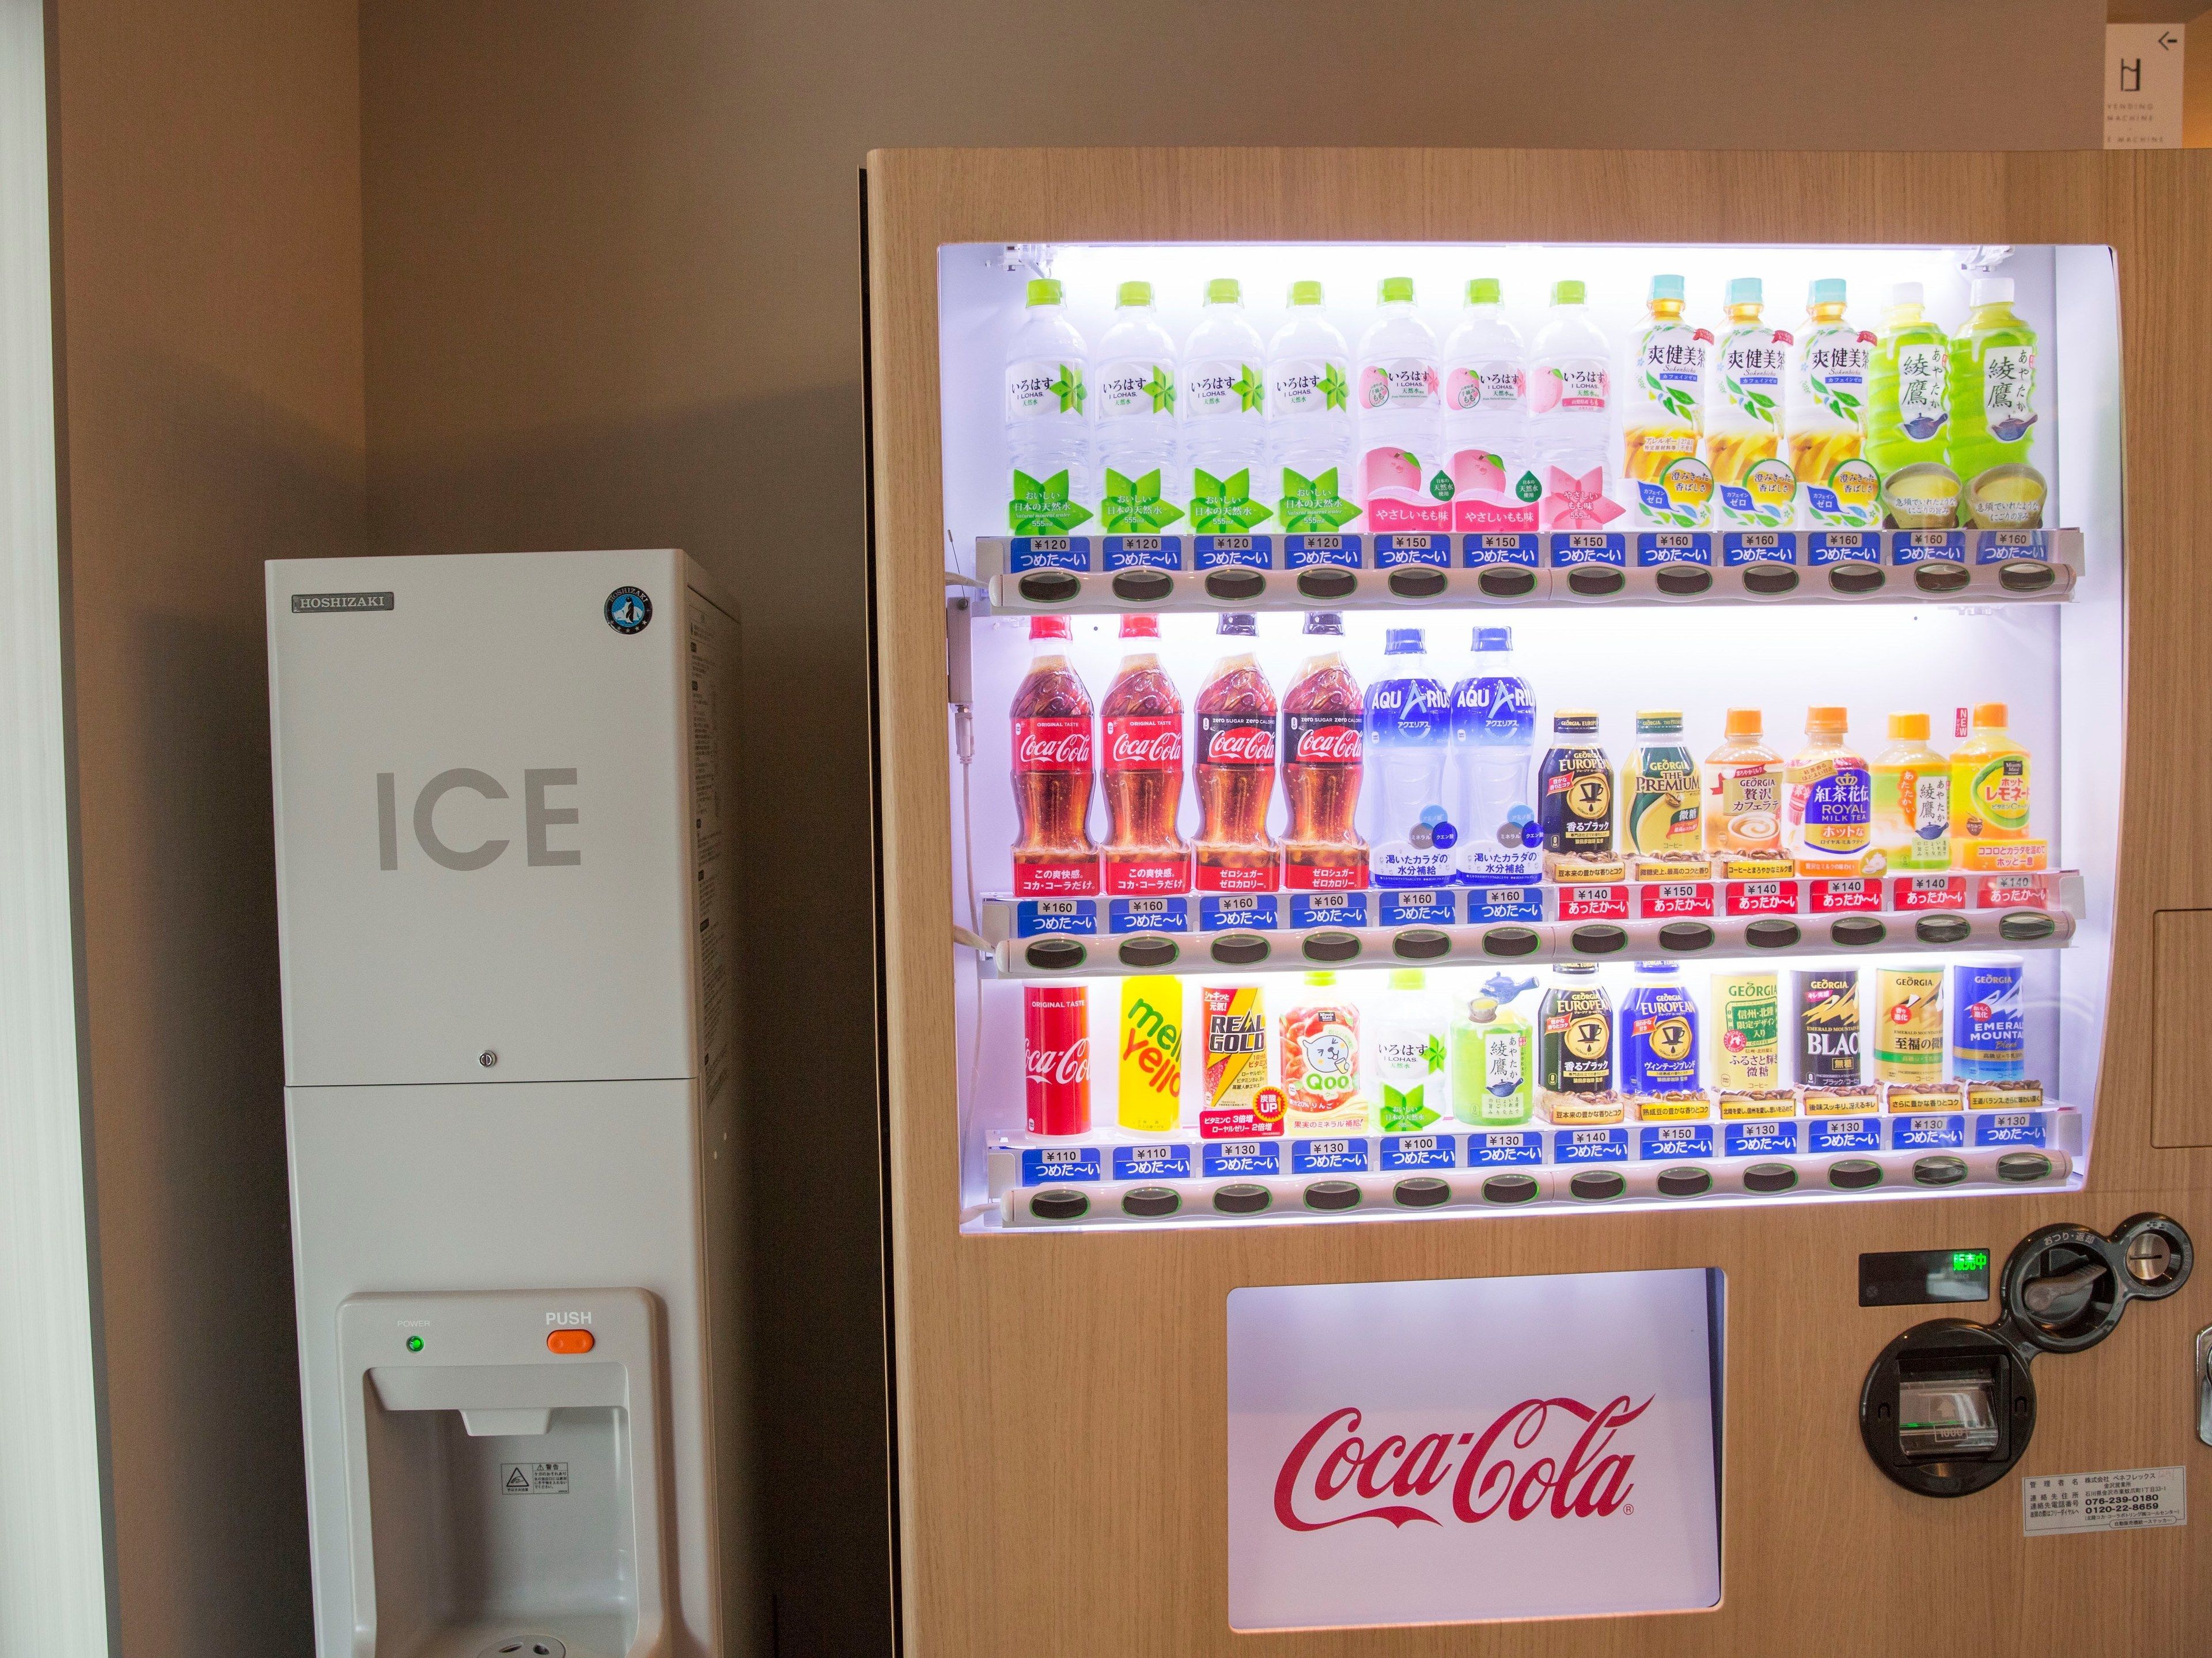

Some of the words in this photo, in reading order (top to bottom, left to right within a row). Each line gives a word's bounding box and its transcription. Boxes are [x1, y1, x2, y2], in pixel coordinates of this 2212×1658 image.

[1648, 345, 1706, 366] 爽健美茶
[1902, 353, 1931, 405] 綾鷹
[1930, 348, 1942, 407] あやたか
[1671, 473, 1709, 481] 澄みきった
[1675, 483, 1706, 492] 香ばしさ
[1026, 492, 1059, 500] おいしい
[1564, 491, 1598, 500] やさしい
[1647, 496, 1662, 504] ゼロ
[1015, 503, 1071, 511] 日本の天然水
[1107, 506, 1162, 515] 日本の天然水
[1568, 502, 1593, 511] もも味
[1376, 510, 1449, 521] やさしいもも味
[1127, 539, 1158, 548] ¥120
[1217, 538, 1249, 548] ¥120
[1308, 537, 1339, 547] ¥120
[1396, 537, 1426, 547] ¥150
[1486, 537, 1516, 547] ¥150
[1573, 536, 1603, 547] ¥150
[1660, 536, 1688, 546] ¥160
[1747, 535, 1774, 545] ¥160
[1831, 535, 1858, 545] ¥160
[1915, 534, 1942, 545] ¥160
[1999, 534, 2027, 544] ¥160
[1035, 540, 1066, 549] ¥120
[609, 588, 648, 602] HOSHIZAKI
[300, 597, 384, 608] HOSHIZAKI
[1959, 710, 1967, 736] NEW
[1021, 734, 1090, 762] Coca-Cola
[1209, 731, 1275, 759] Coca-Cola
[1637, 776, 1699, 791] PREMIUM
[1744, 788, 1771, 800] 贅沢
[1815, 786, 1869, 802] 紅茶花伝
[1901, 772, 1915, 813] あたたかい
[1733, 801, 1778, 811] カフェラテ
[1919, 784, 1936, 818] 綾鷹
[1822, 805, 1866, 814] ROYAL
[377, 768, 581, 871] ICE
[1566, 821, 1609, 831] 香るブラック
[1823, 826, 1864, 837] ホットな
[1386, 854, 1448, 863] 渇いたカラダの
[1997, 858, 2033, 866] ホッと一息
[1220, 870, 1263, 878] ゼロシュガー
[1397, 866, 1436, 875] 水分補給
[1558, 868, 1622, 877] 豆本来の豊かな香りとコク
[1832, 882, 1861, 891] ¥140
[1916, 879, 1945, 888] ¥140
[2001, 878, 2028, 887] ¥140
[1578, 889, 1607, 899] ¥140
[1664, 886, 1692, 896] ¥150
[1748, 885, 1777, 894] ¥140
[1315, 896, 1343, 906] ¥160
[1403, 894, 1431, 904] ¥160
[1491, 891, 1520, 901] ¥160
[1043, 902, 1072, 913] ¥160
[1134, 901, 1163, 911] ¥160
[1224, 898, 1252, 909] ¥160
[1642, 1001, 1695, 1015] EUROPEAN
[1211, 1010, 1264, 1034] REAL
[1210, 1033, 1264, 1053] GOLD
[1306, 1073, 1349, 1090] Qoo
[1260, 1094, 1277, 1103] 炭酸
[1893, 1099, 1959, 1108] さらに豊かな香りとコク
[1261, 1103, 1277, 1113] UP
[1915, 1120, 1943, 1129] ¥130
[1998, 1117, 2026, 1126] ¥130
[1747, 1125, 1775, 1135] ¥130
[1831, 1123, 1859, 1132] ¥130
[1577, 1133, 1605, 1143] ¥140
[1662, 1129, 1691, 1139] ¥150
[1404, 1139, 1433, 1149] ¥100
[1490, 1136, 1519, 1145] ¥130
[1225, 1145, 1255, 1155] ¥130
[1313, 1143, 1343, 1153] ¥130
[1047, 1151, 1076, 1161] ¥110
[1138, 1148, 1166, 1159] ¥110
[1953, 1253, 1986, 1271] 販売中
[546, 1312, 592, 1325] PUSH
[1274, 1393, 1656, 1532] Coca-Cola
[2085, 1494, 2158, 1505] 076-239-0180
[2085, 1503, 2158, 1514] 0120-22-8659
